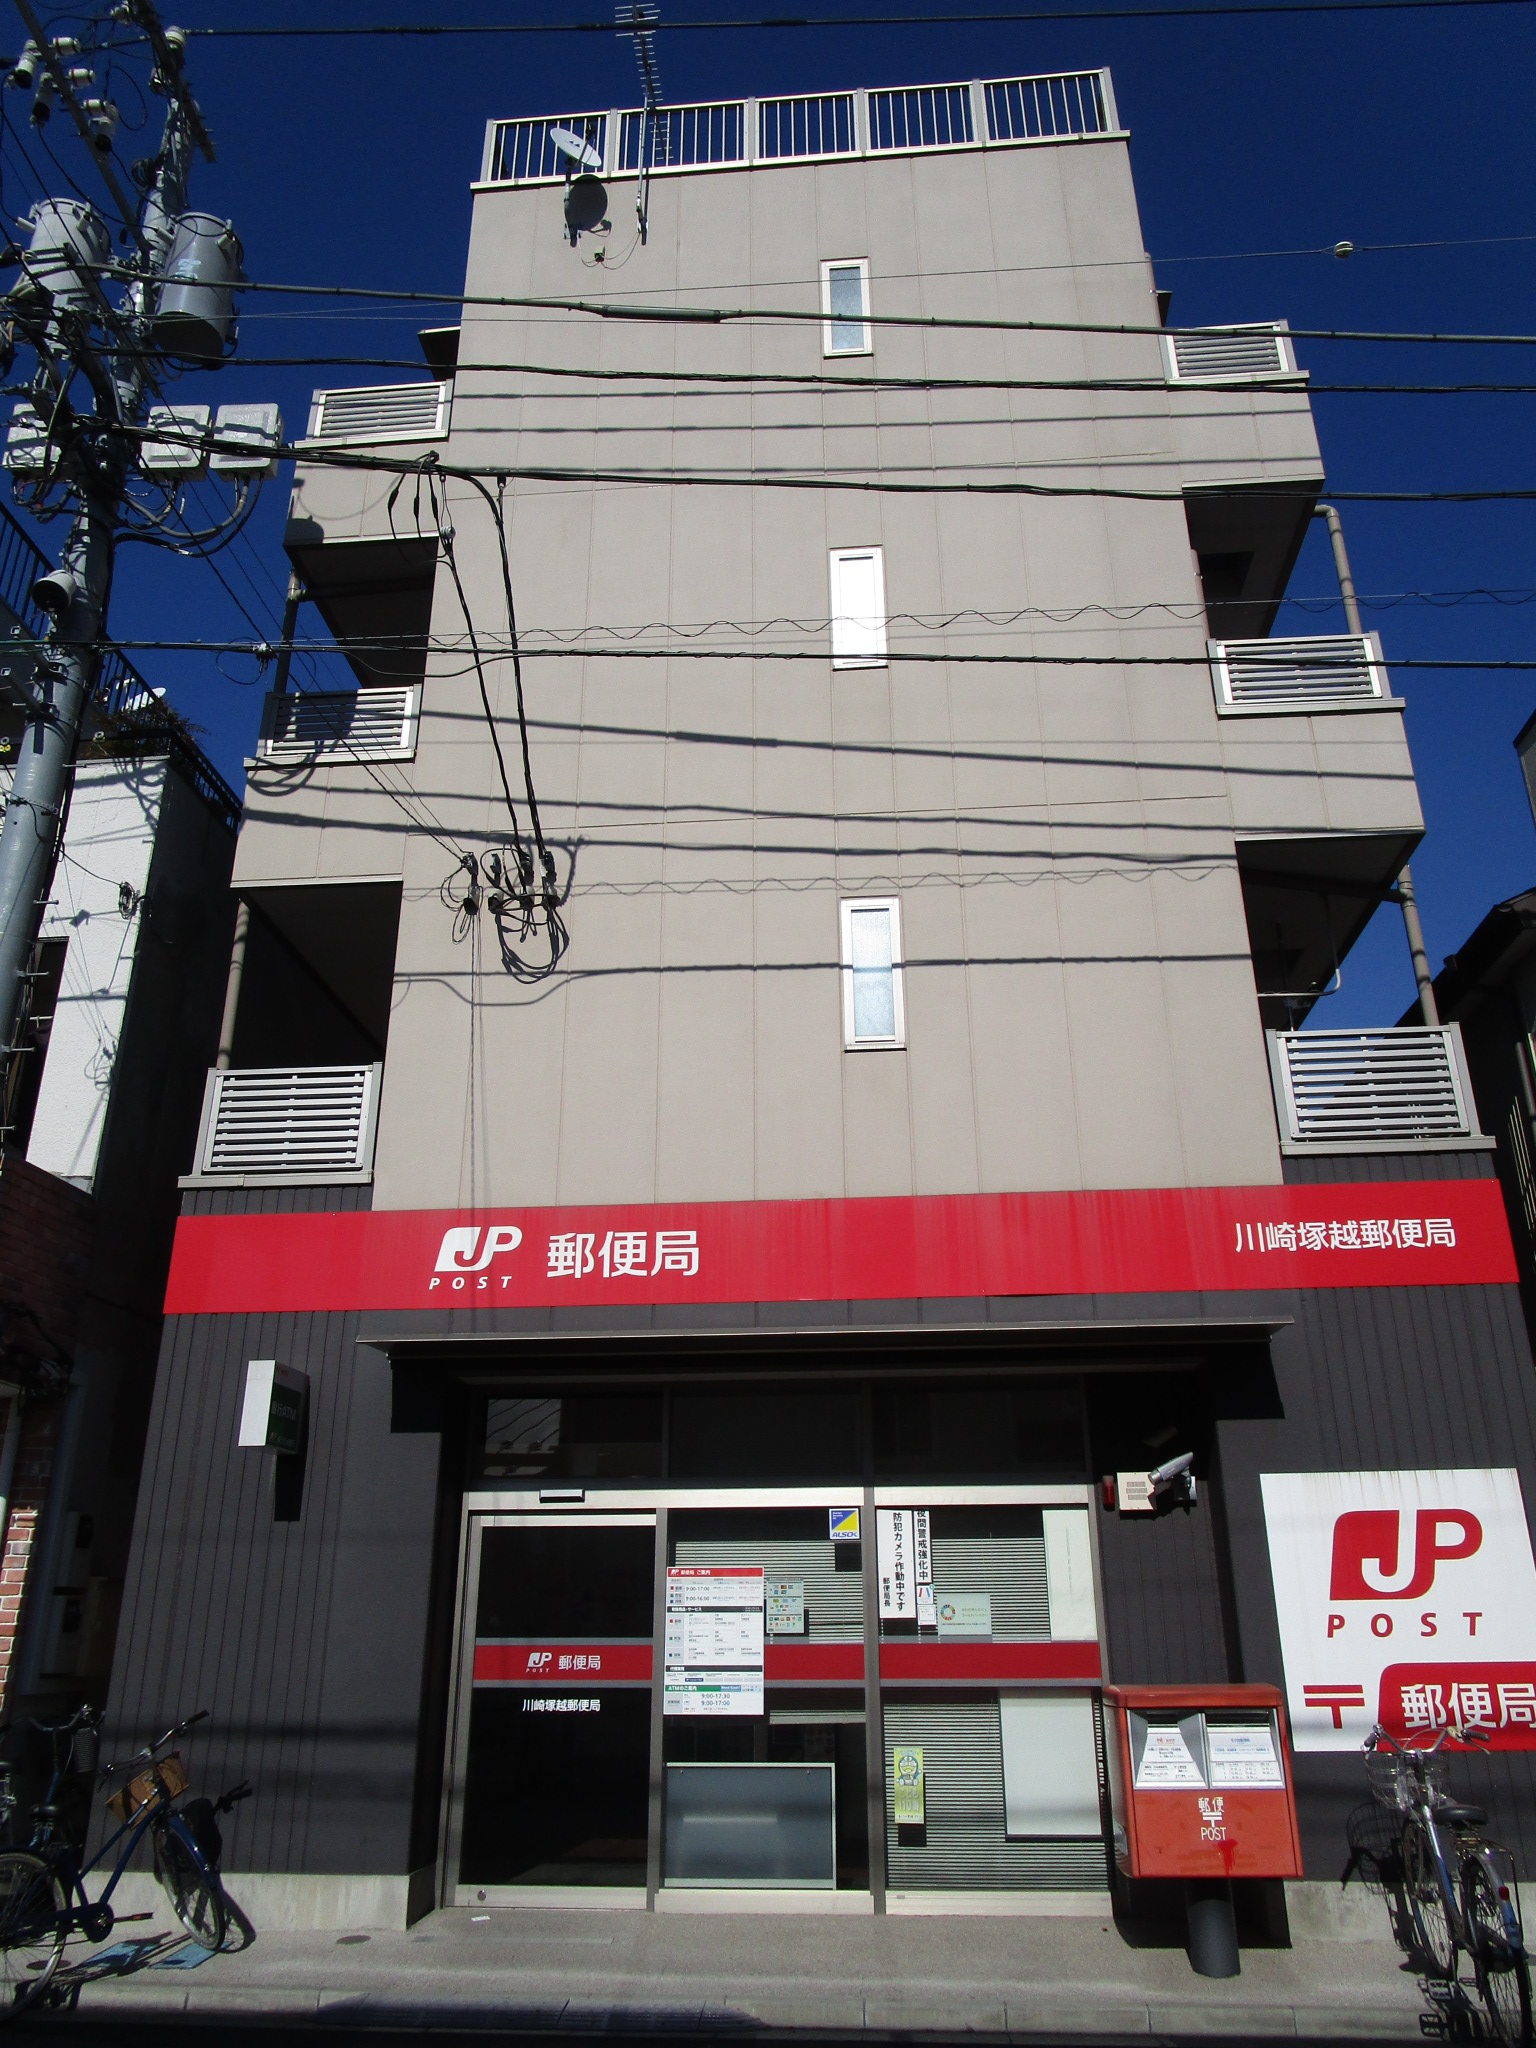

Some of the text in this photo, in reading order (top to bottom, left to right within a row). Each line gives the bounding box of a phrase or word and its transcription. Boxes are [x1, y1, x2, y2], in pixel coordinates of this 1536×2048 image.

[434, 1225, 523, 1273] JP
[1235, 1218, 1457, 1252] 川崎塚越郵便局
[547, 1230, 700, 1278] 郵便局
[429, 1275, 512, 1290] POST
[917, 1511, 929, 1581] 夜間警戒強化中
[1329, 1508, 1483, 1601] JP
[893, 1512, 906, 1612] 防犯カメラ作動中です
[883, 1577, 891, 1607] 郵便局長
[1327, 1612, 1483, 1639] POST
[527, 1652, 552, 1668] JP
[558, 1655, 601, 1671] 郵便局
[522, 1699, 601, 1712] 川崎塚越郵便局
[1400, 1682, 1536, 1729] 郵便局
[1198, 1796, 1225, 1813] 郵便
[1200, 1827, 1226, 1841] POST
